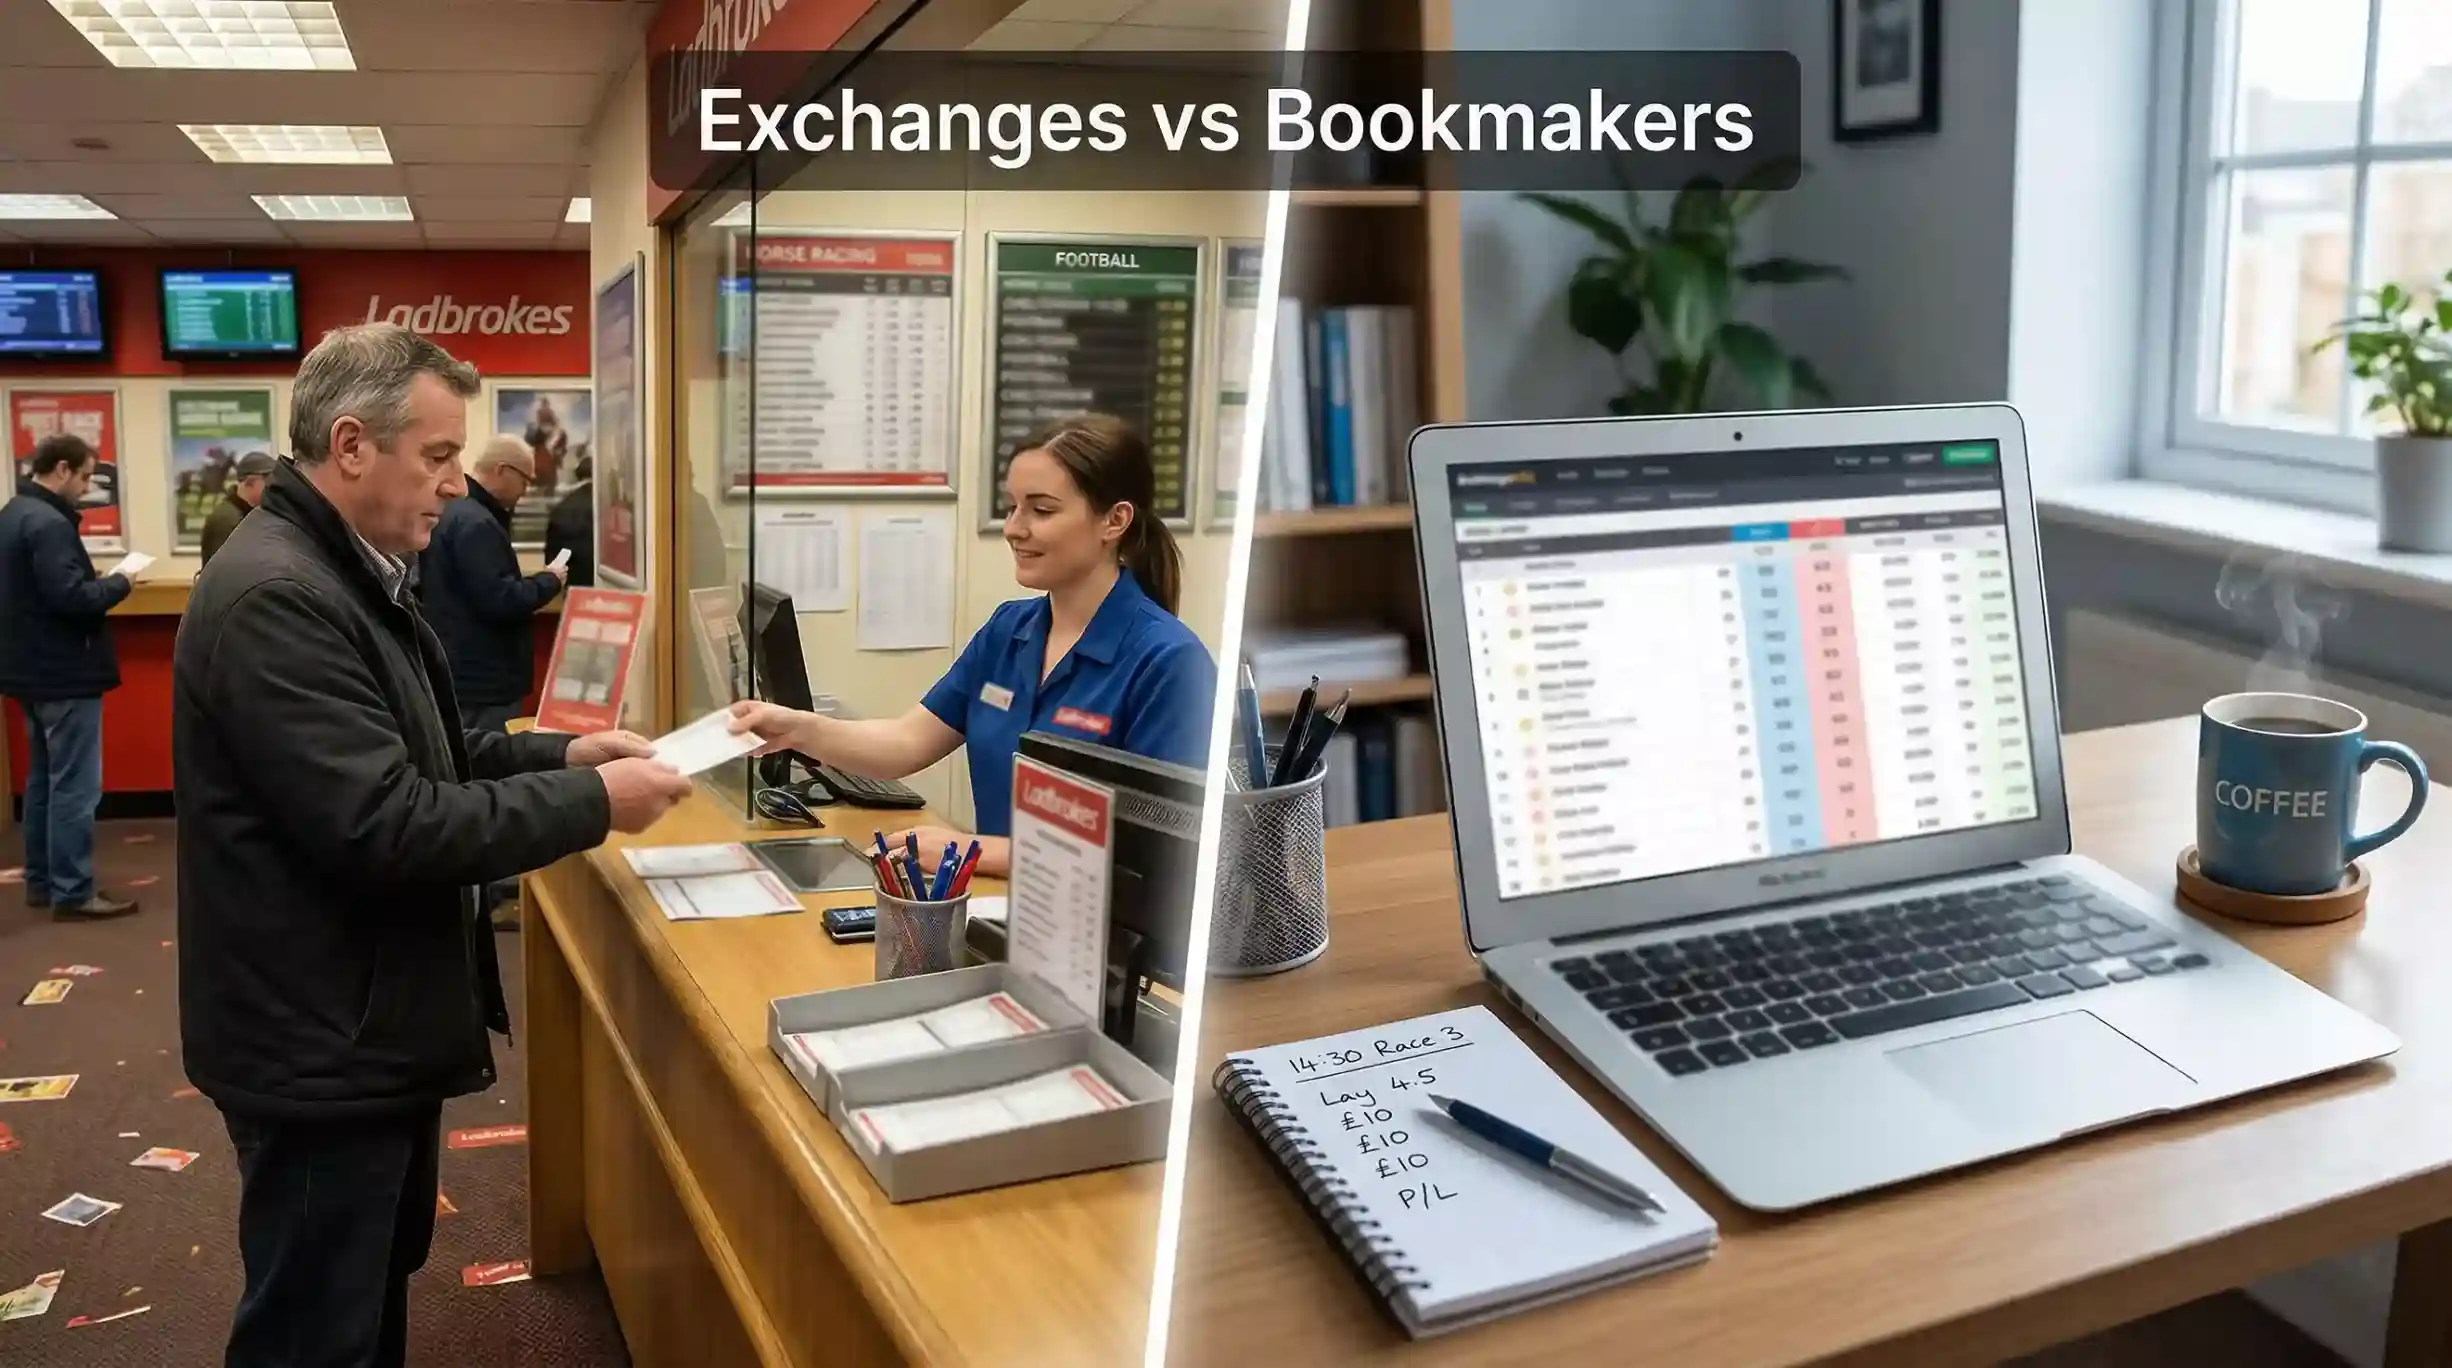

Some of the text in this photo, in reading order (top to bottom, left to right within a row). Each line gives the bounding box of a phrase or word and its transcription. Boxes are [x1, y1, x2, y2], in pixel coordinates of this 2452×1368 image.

[668, 0, 788, 137] Ladbro
[1055, 251, 1140, 269] FOOTBALL
[2215, 779, 2329, 818] COFFEE
[1289, 1026, 1464, 1074] 14:30 Race 3
[1319, 1067, 1437, 1107] Lay 4.5
[1340, 1108, 1393, 1131] £10
[1356, 1130, 1409, 1154] £10
[1375, 1153, 1429, 1179] £10
[1398, 1182, 1458, 1210] P/L
